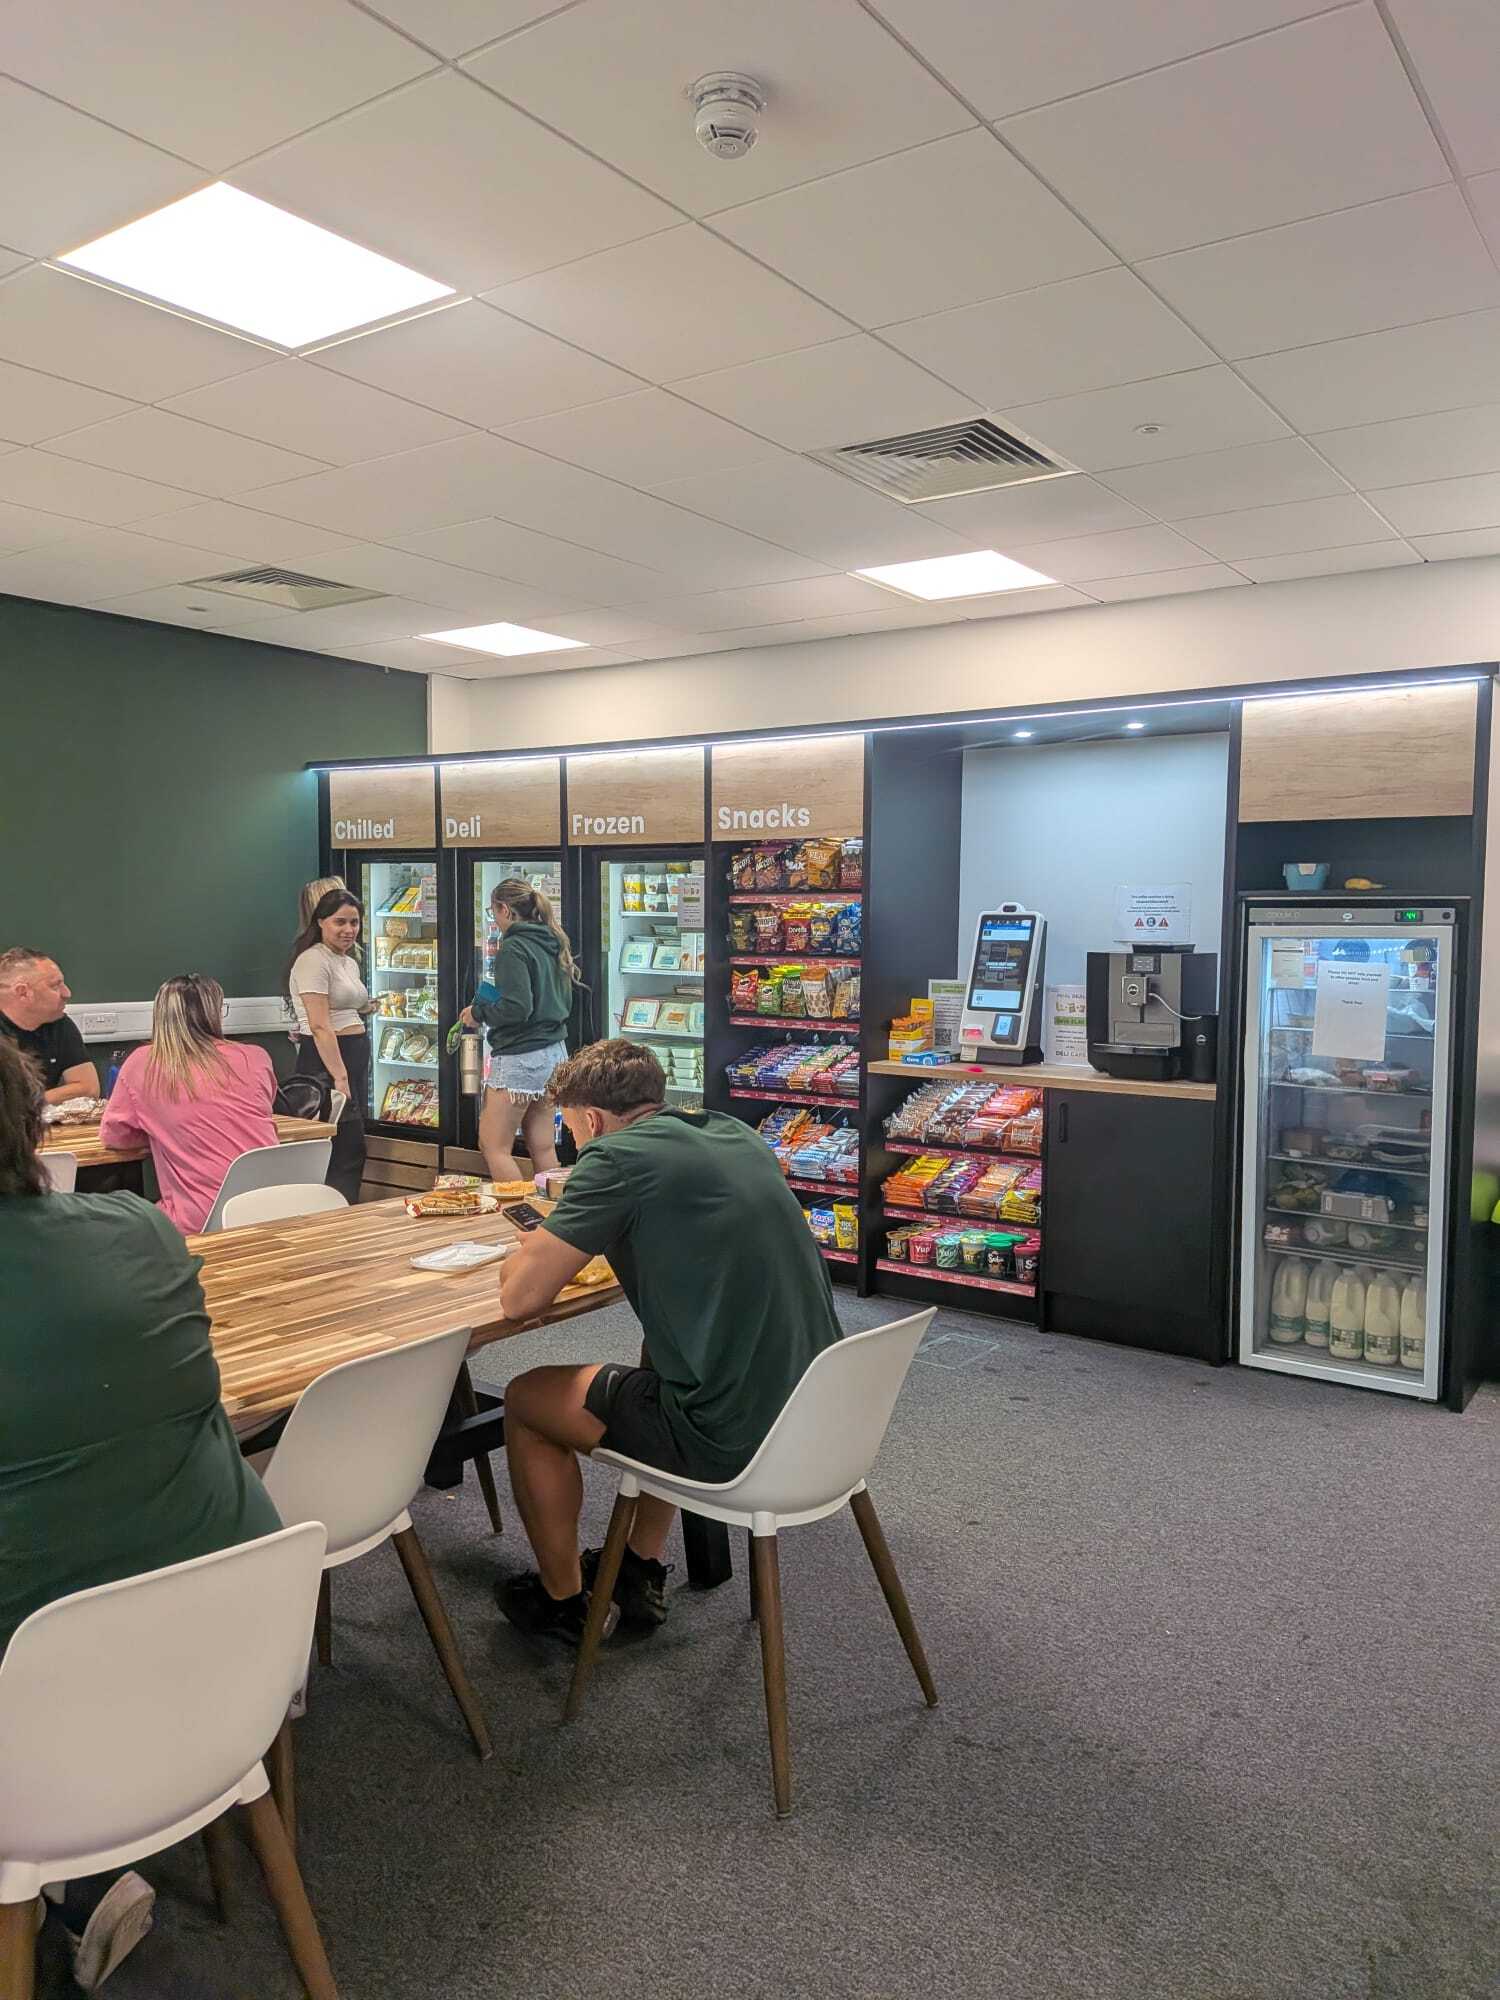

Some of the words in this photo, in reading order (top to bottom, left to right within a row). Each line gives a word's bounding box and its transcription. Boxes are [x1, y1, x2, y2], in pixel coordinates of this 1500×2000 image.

[445, 815, 481, 839] Deli
[572, 814, 645, 836] Frozen
[718, 803, 811, 830] Snacks
[334, 818, 395, 840] Chilled
